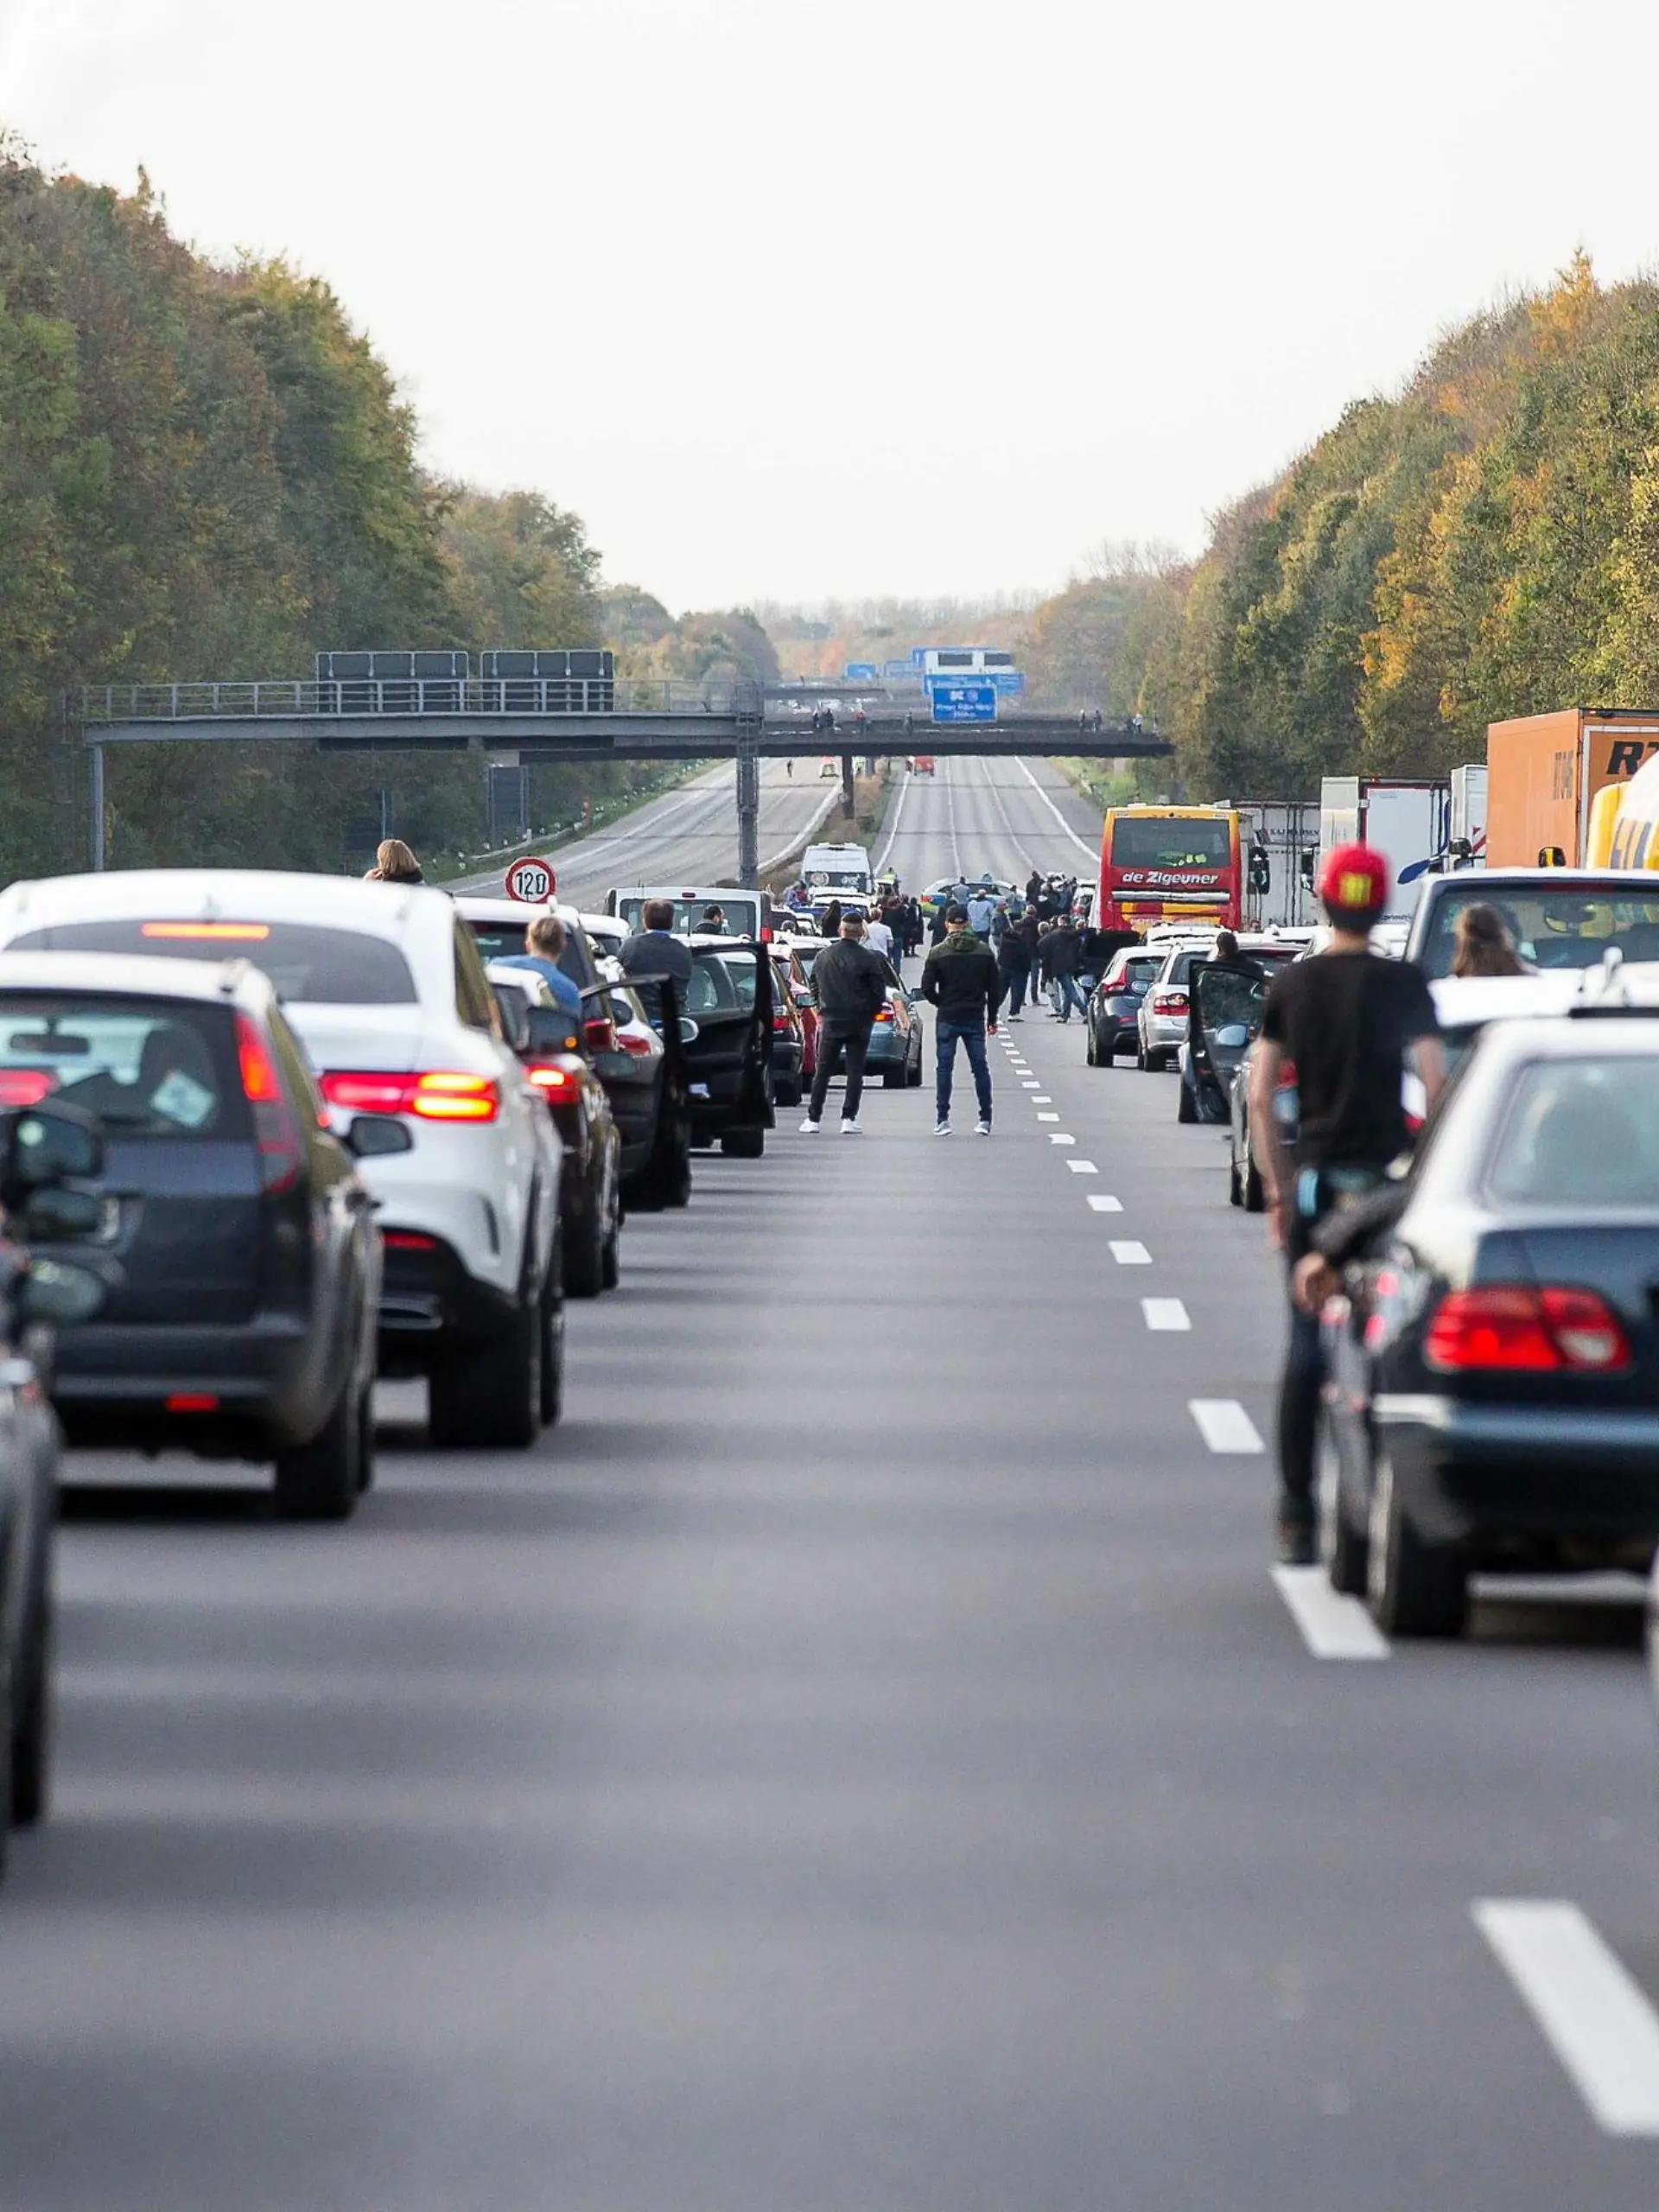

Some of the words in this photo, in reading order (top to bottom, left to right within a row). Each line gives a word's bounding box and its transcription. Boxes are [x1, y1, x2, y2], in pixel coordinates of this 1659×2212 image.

[1605, 741, 1659, 775] R
[516, 872, 546, 894] 120
[1122, 872, 1143, 883] de
[1146, 871, 1218, 885] Zigeuner
